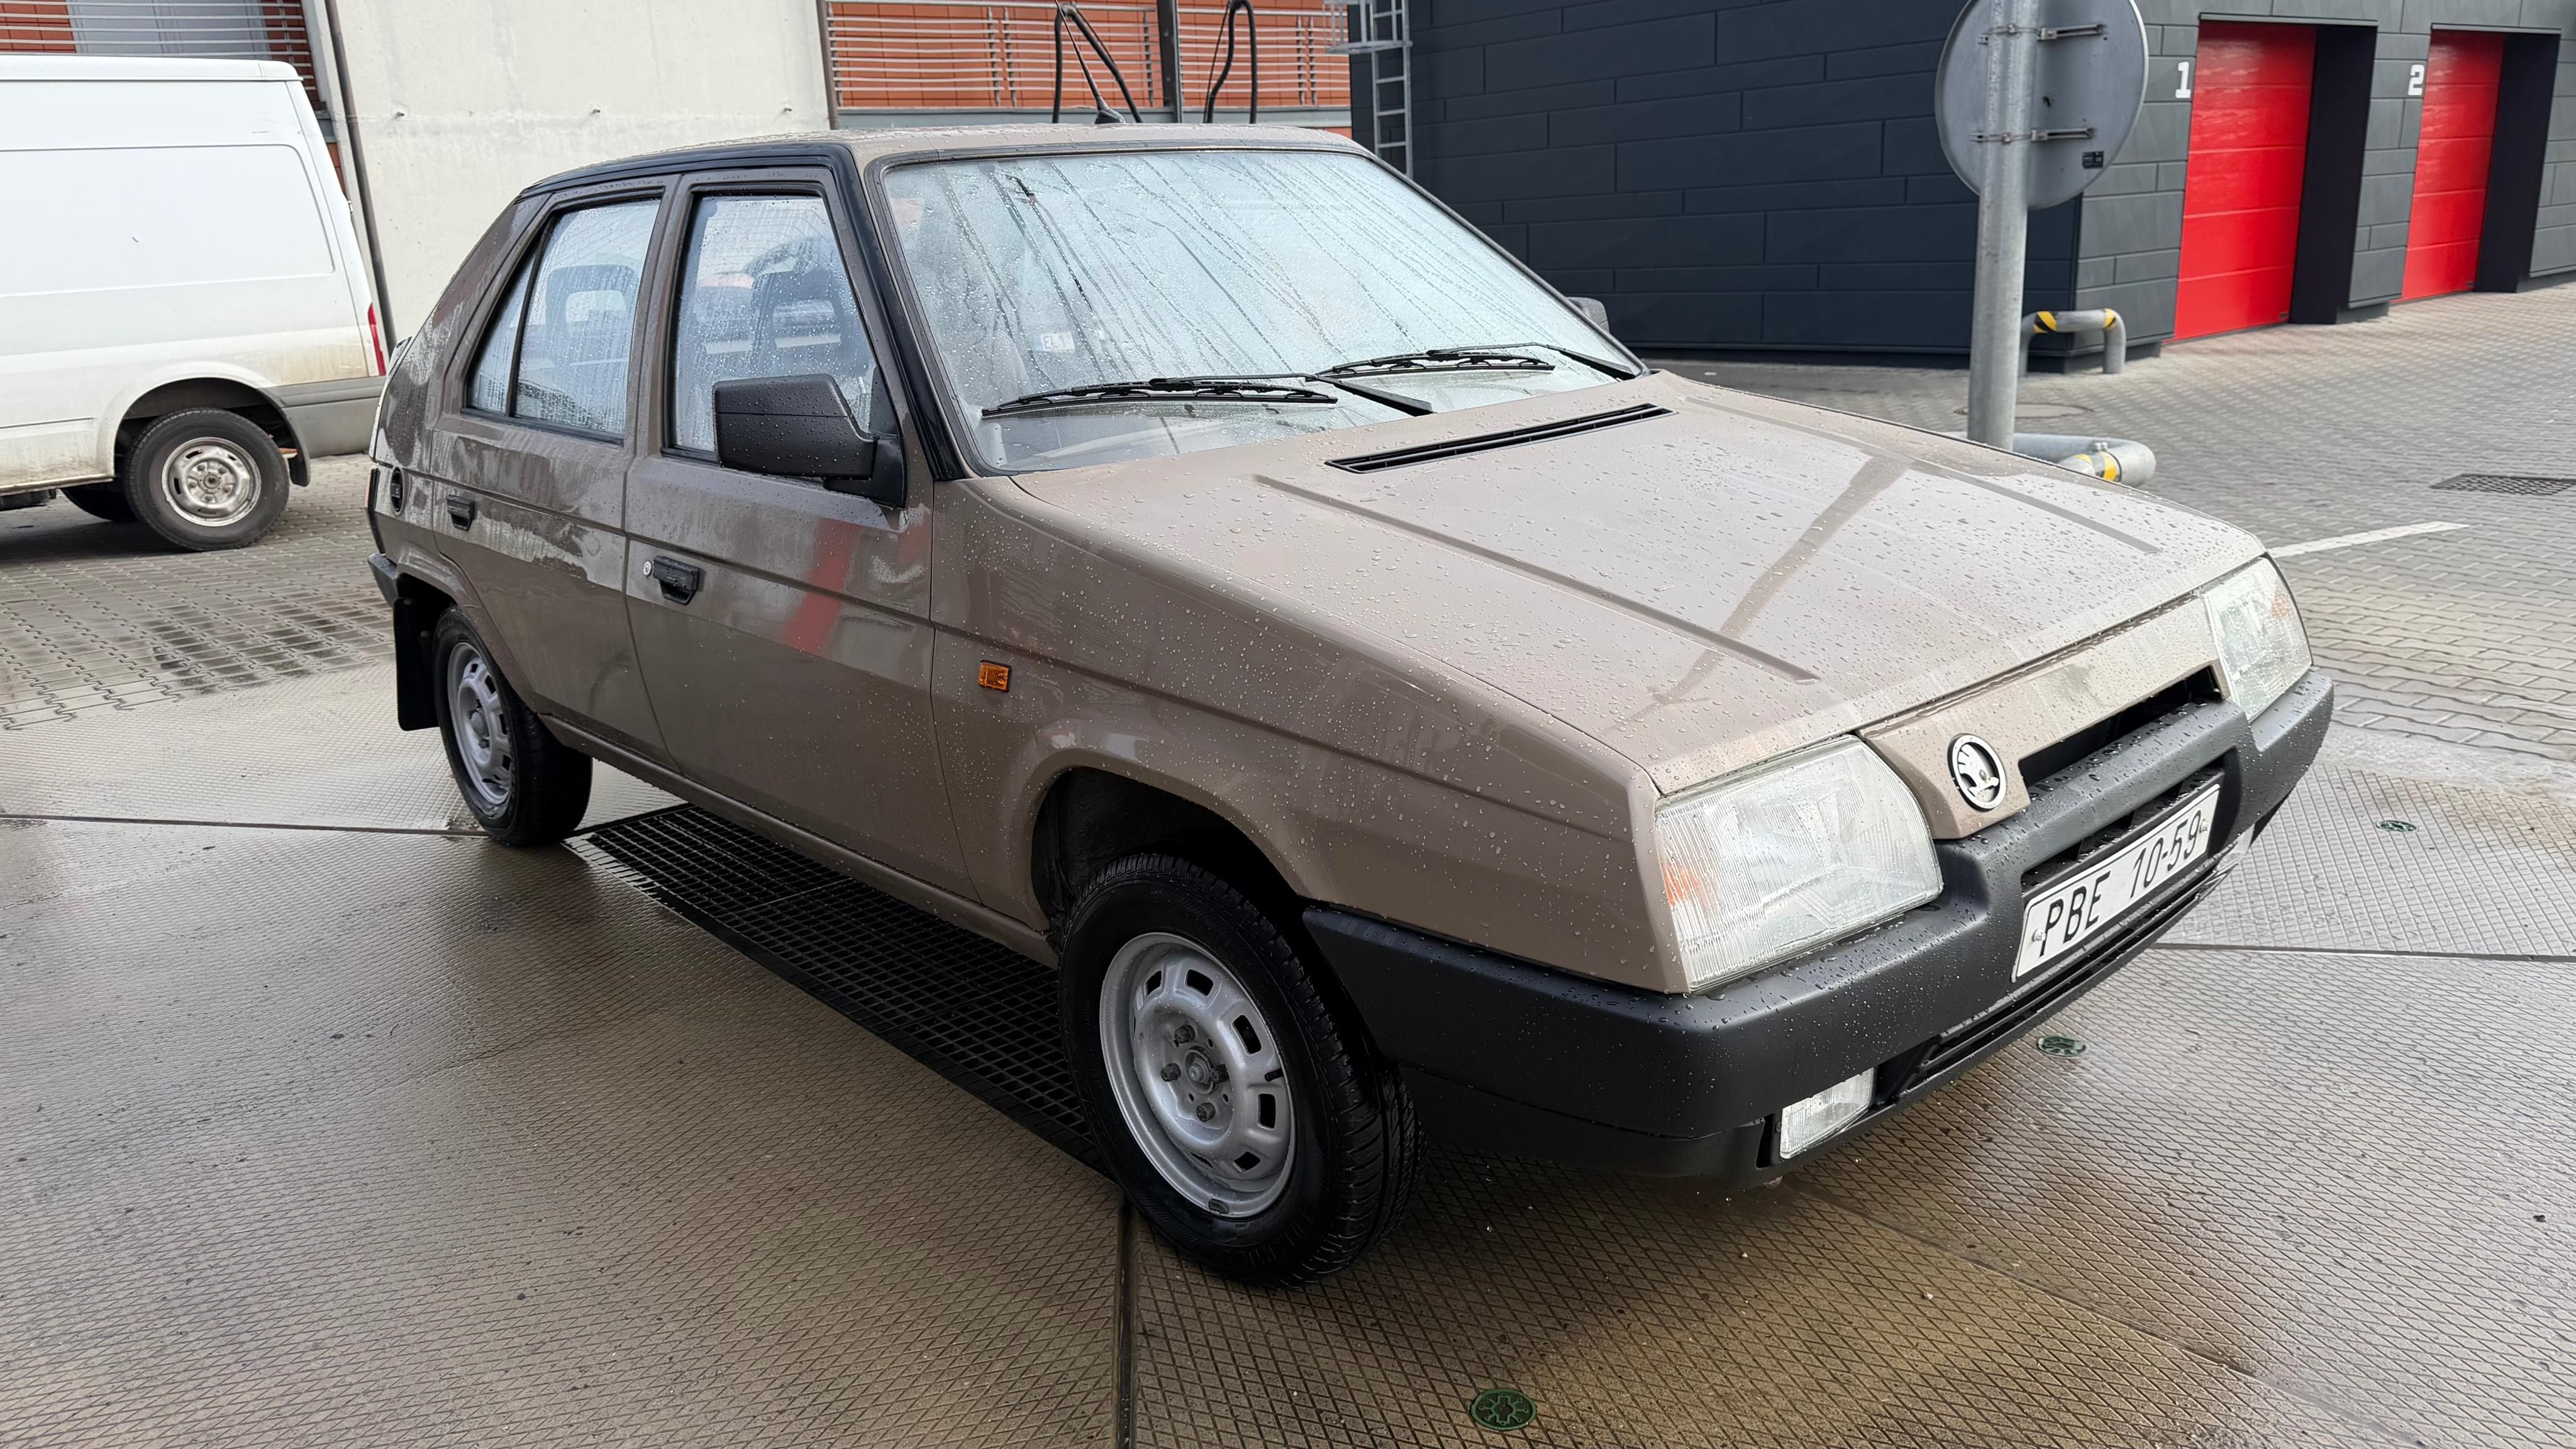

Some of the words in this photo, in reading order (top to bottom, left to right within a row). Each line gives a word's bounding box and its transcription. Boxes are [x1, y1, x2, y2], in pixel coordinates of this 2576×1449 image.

[2175, 61, 2191, 99] 1
[2407, 64, 2425, 96] 2
[2039, 871, 2111, 957] PBE
[2130, 809, 2202, 899] 10-59
